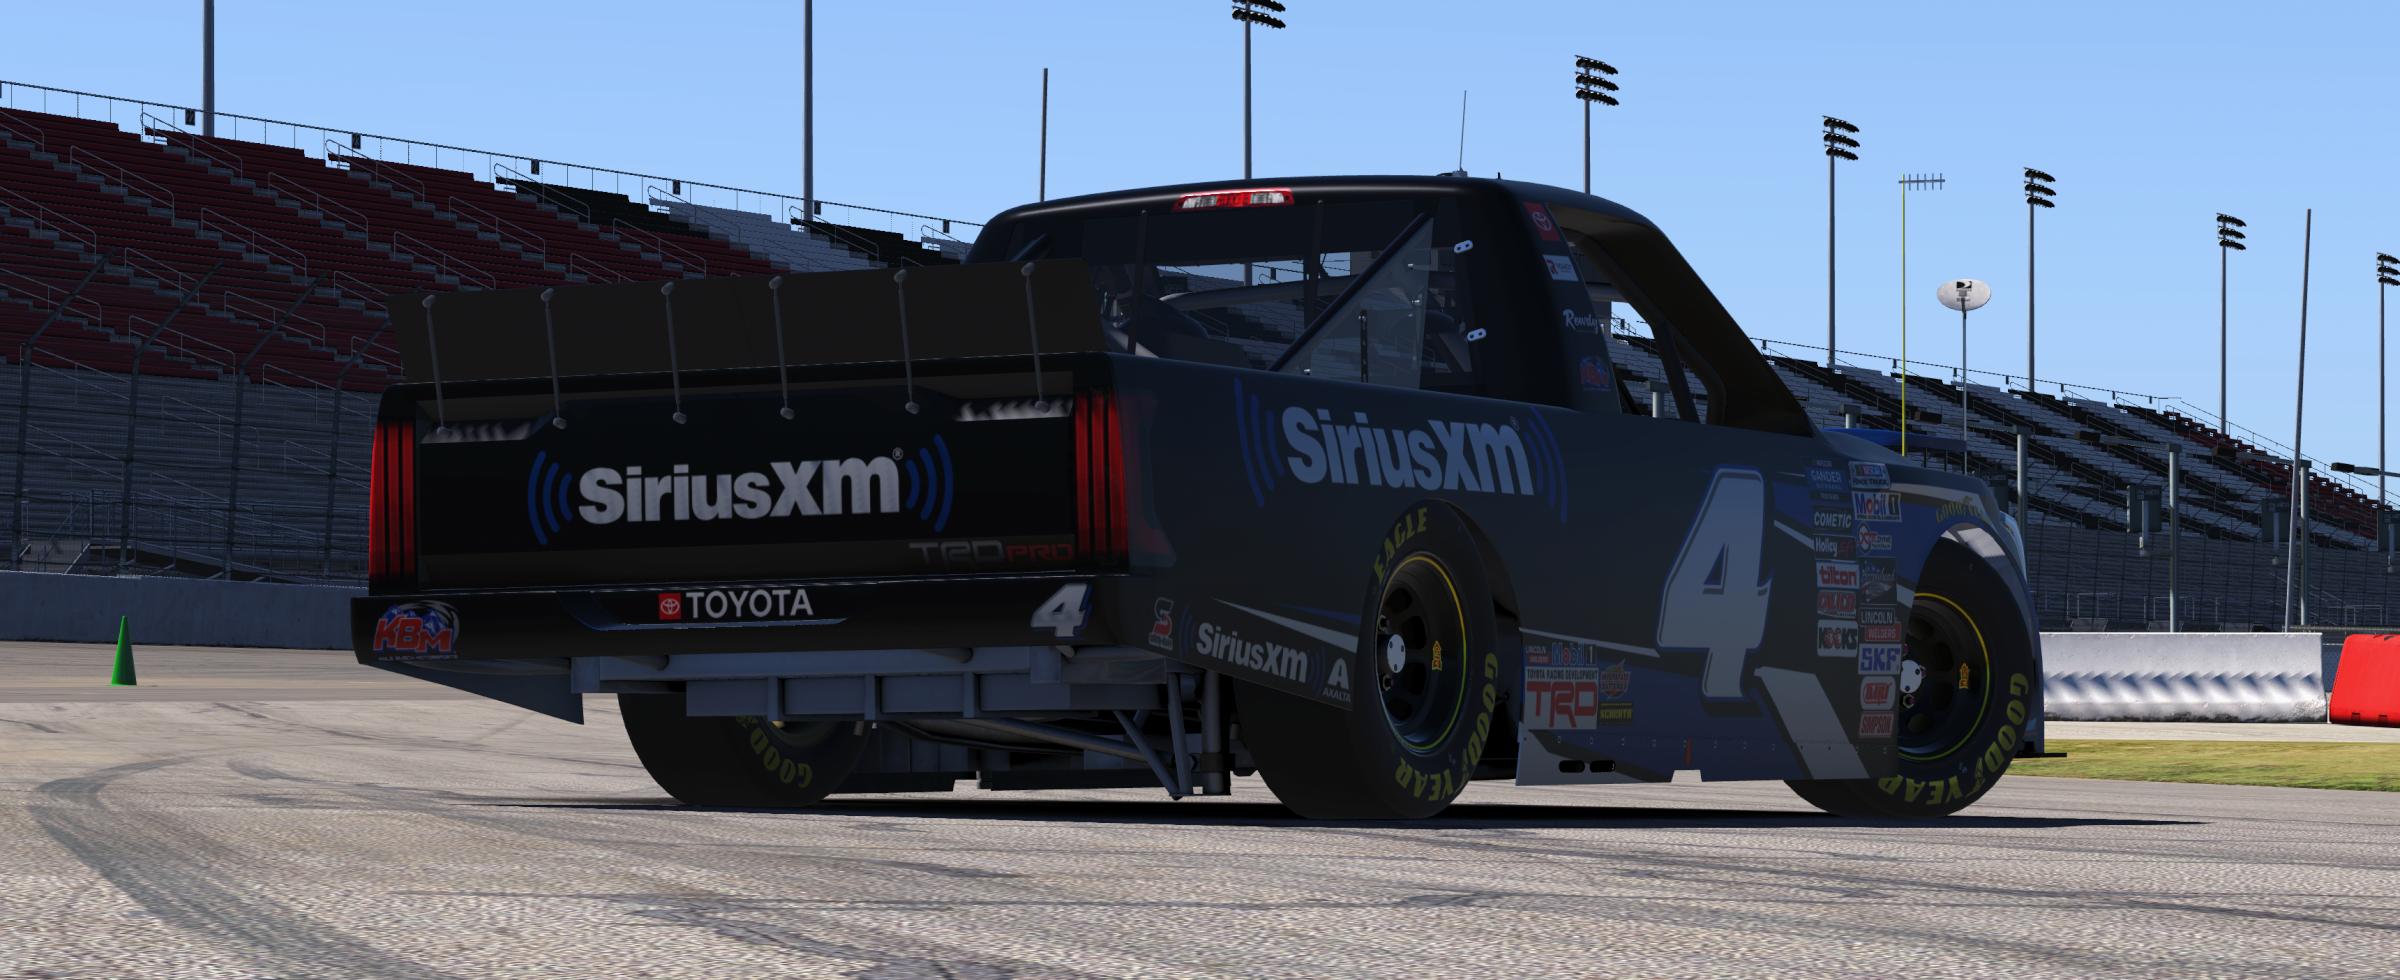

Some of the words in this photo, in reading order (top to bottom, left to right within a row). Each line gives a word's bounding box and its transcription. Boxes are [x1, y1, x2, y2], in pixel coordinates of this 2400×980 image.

[1854, 493, 1888, 515] Mobil
[1814, 511, 1852, 529] COMETIC
[1373, 506, 1429, 585] EAGLE
[1815, 537, 1838, 558] Holley
[1656, 467, 1773, 698] 4
[1819, 564, 1857, 586] tilton
[686, 588, 815, 619] TOYOTA
[1030, 582, 1094, 638] 4
[1861, 609, 1894, 625] LINCOLN
[373, 615, 454, 653] KBM
[1860, 647, 1901, 672] SKF
[1526, 681, 1598, 728] TRD
